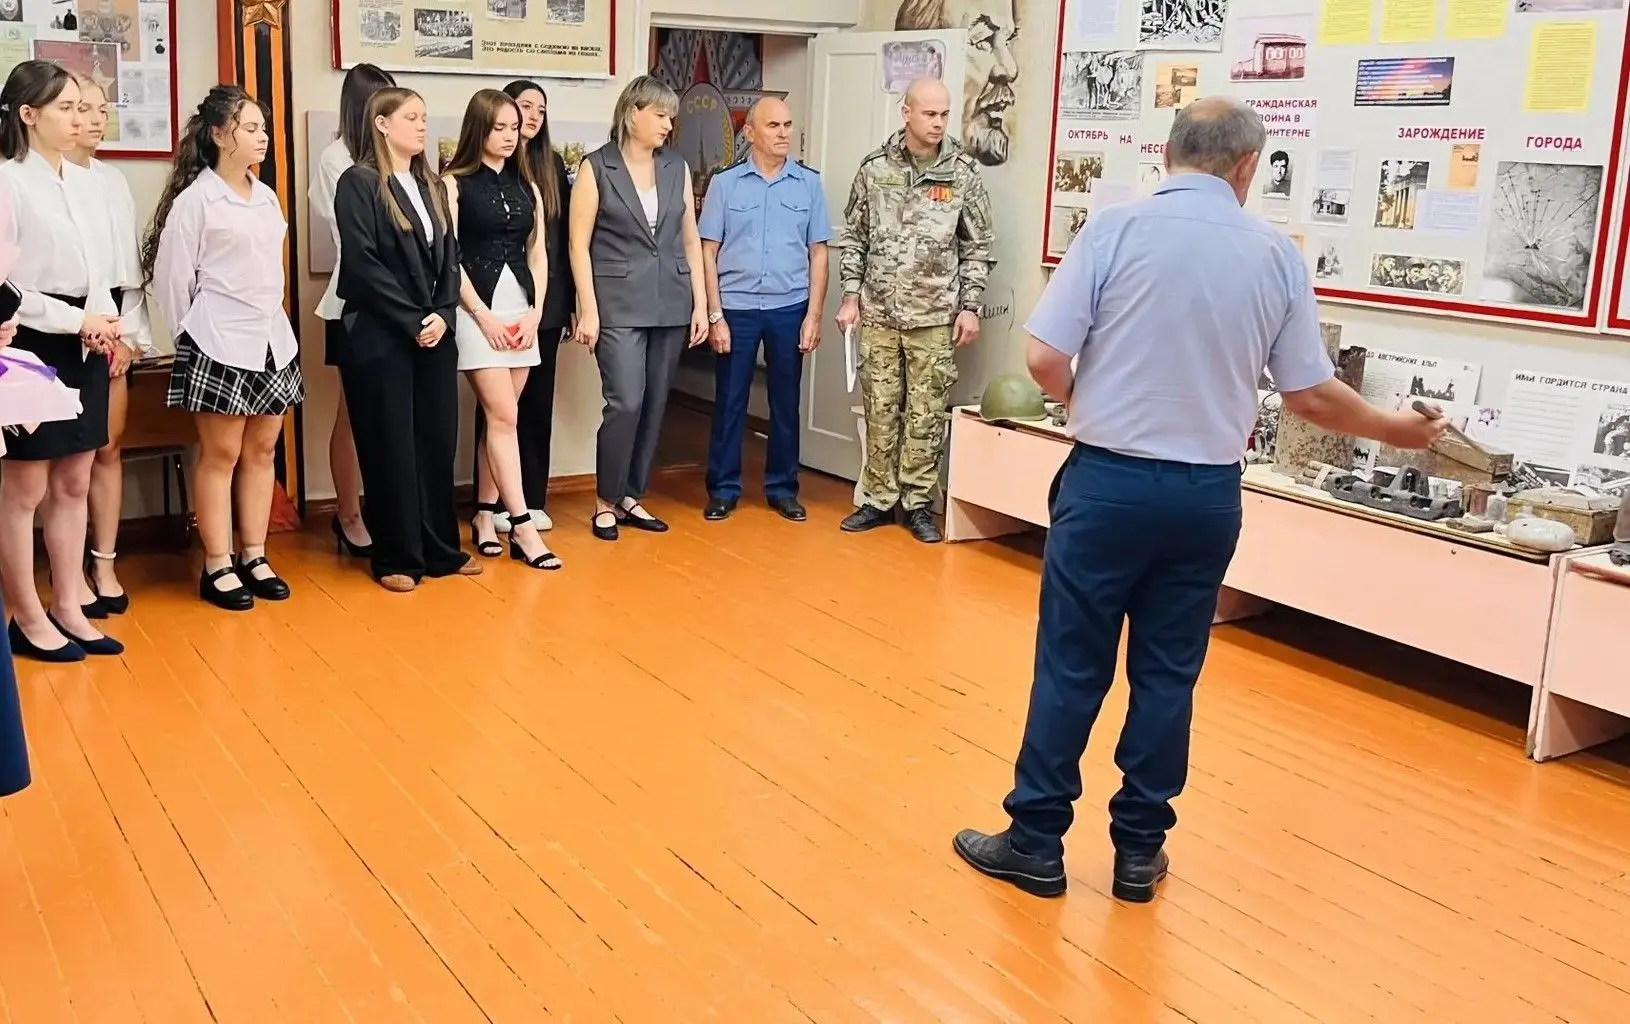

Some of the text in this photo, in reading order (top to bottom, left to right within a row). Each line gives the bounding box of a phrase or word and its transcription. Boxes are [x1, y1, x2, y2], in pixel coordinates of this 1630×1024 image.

[686, 95, 718, 114] СССР
[1245, 99, 1318, 109] ГРАЖДАНСКАЯ
[1294, 114, 1301, 123] В
[1068, 129, 1109, 140] ОКТЯБРЬ
[1119, 134, 1133, 144] НА
[1397, 127, 1583, 150] ЗАРОЖДЕНИЕ ГОРОДА
[1515, 373, 1628, 395] ИМИ ГОРДИТСЯ СТРАНА
